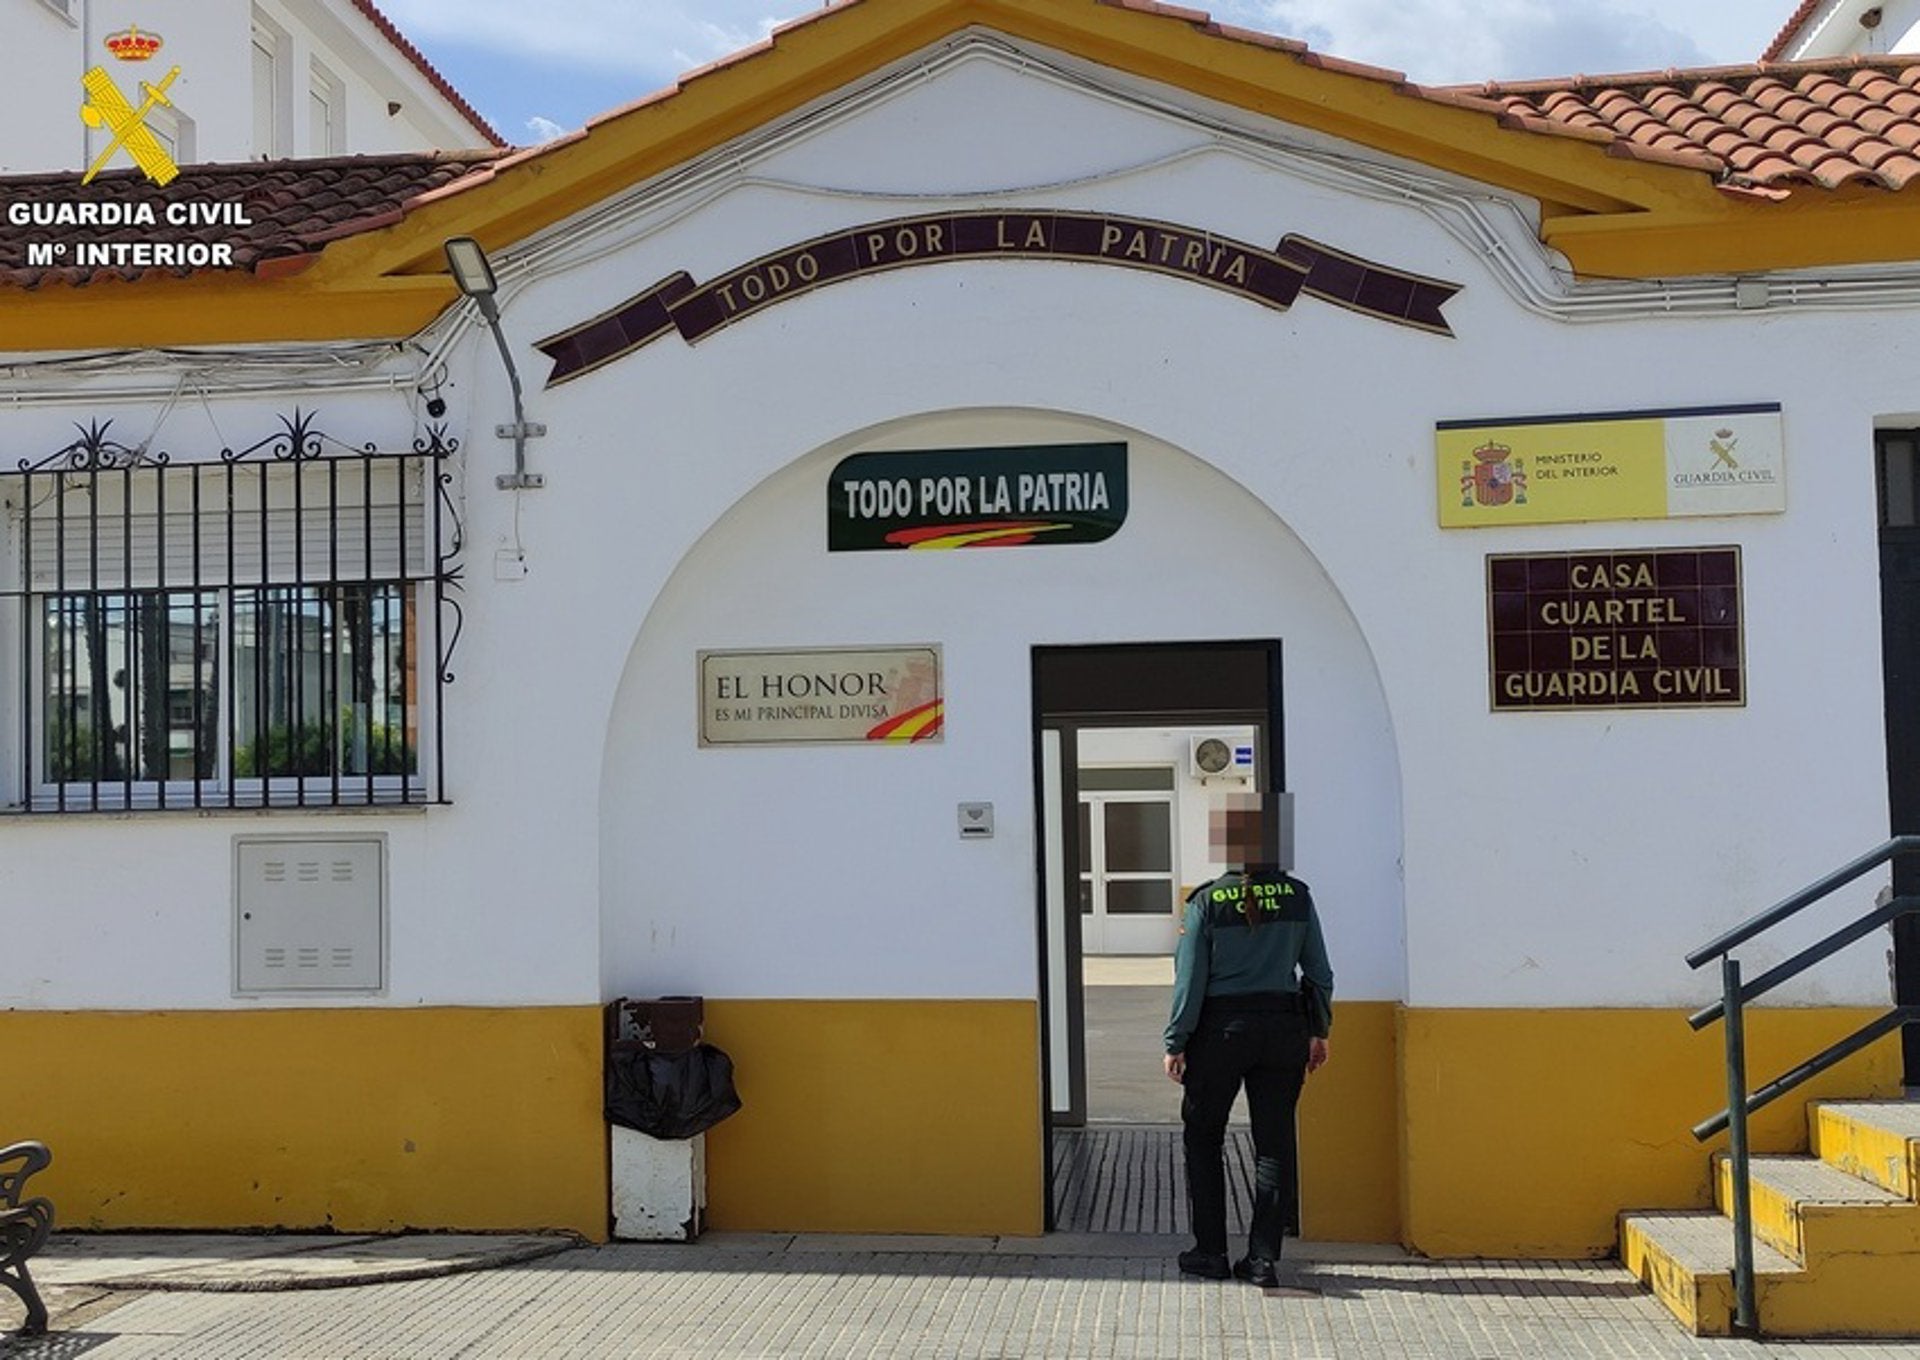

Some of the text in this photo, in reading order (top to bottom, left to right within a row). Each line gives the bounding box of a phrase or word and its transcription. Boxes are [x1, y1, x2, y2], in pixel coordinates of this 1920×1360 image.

[716, 220, 1246, 311] TODO POR LA PATRIA
[1535, 452, 1602, 464] MINISTERIO
[1536, 467, 1618, 479] DEL INTERIOR
[1674, 469, 1774, 484] GUARDIA CIVIL
[844, 472, 1110, 518] TODO POR LA PATRIA
[1571, 563, 1654, 589] CASA
[1541, 597, 1686, 625] CUARTEL
[1571, 635, 1658, 661] DE LA
[717, 672, 888, 699] EL HONOR
[1505, 668, 1731, 698] GUARDIA CIVIL
[715, 704, 889, 721] ES MI PRINCIPAL DIVISA
